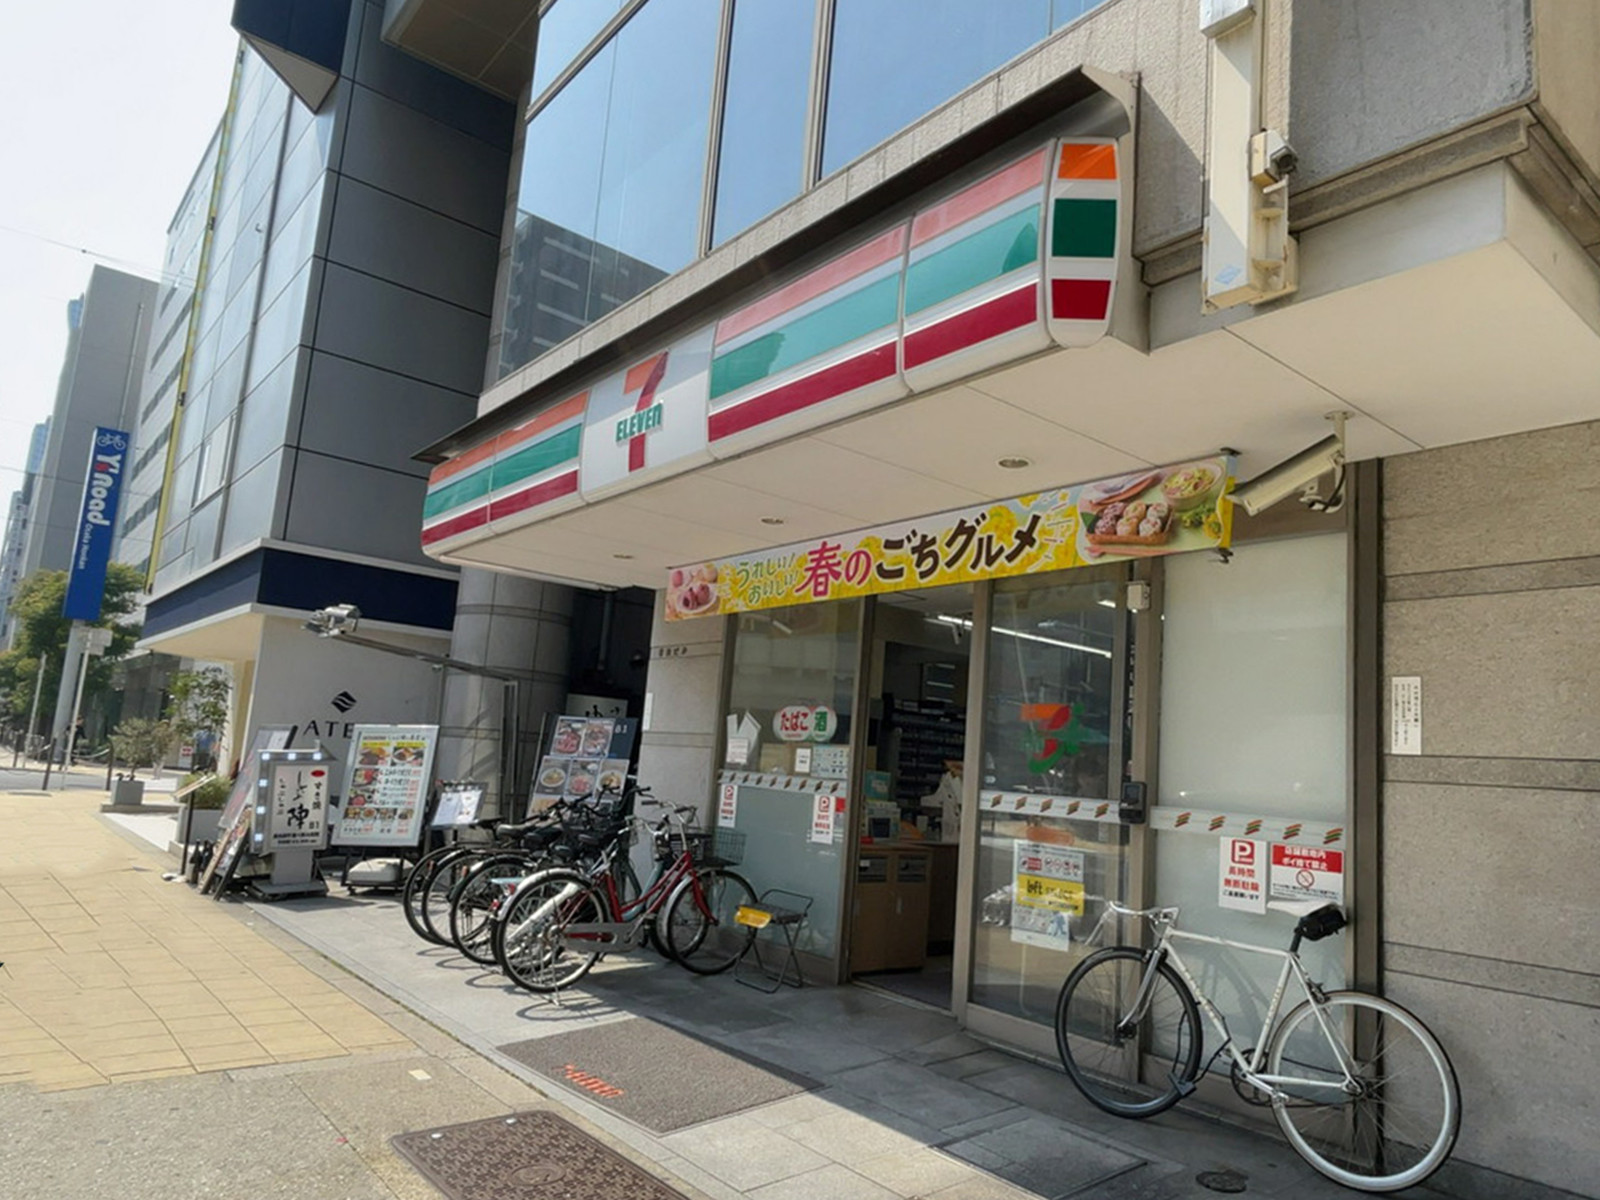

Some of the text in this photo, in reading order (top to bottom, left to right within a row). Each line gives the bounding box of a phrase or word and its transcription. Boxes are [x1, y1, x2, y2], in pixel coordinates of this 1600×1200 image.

[794, 513, 1042, 598] 春のごちグルメ
[779, 710, 811, 732] たばこ
